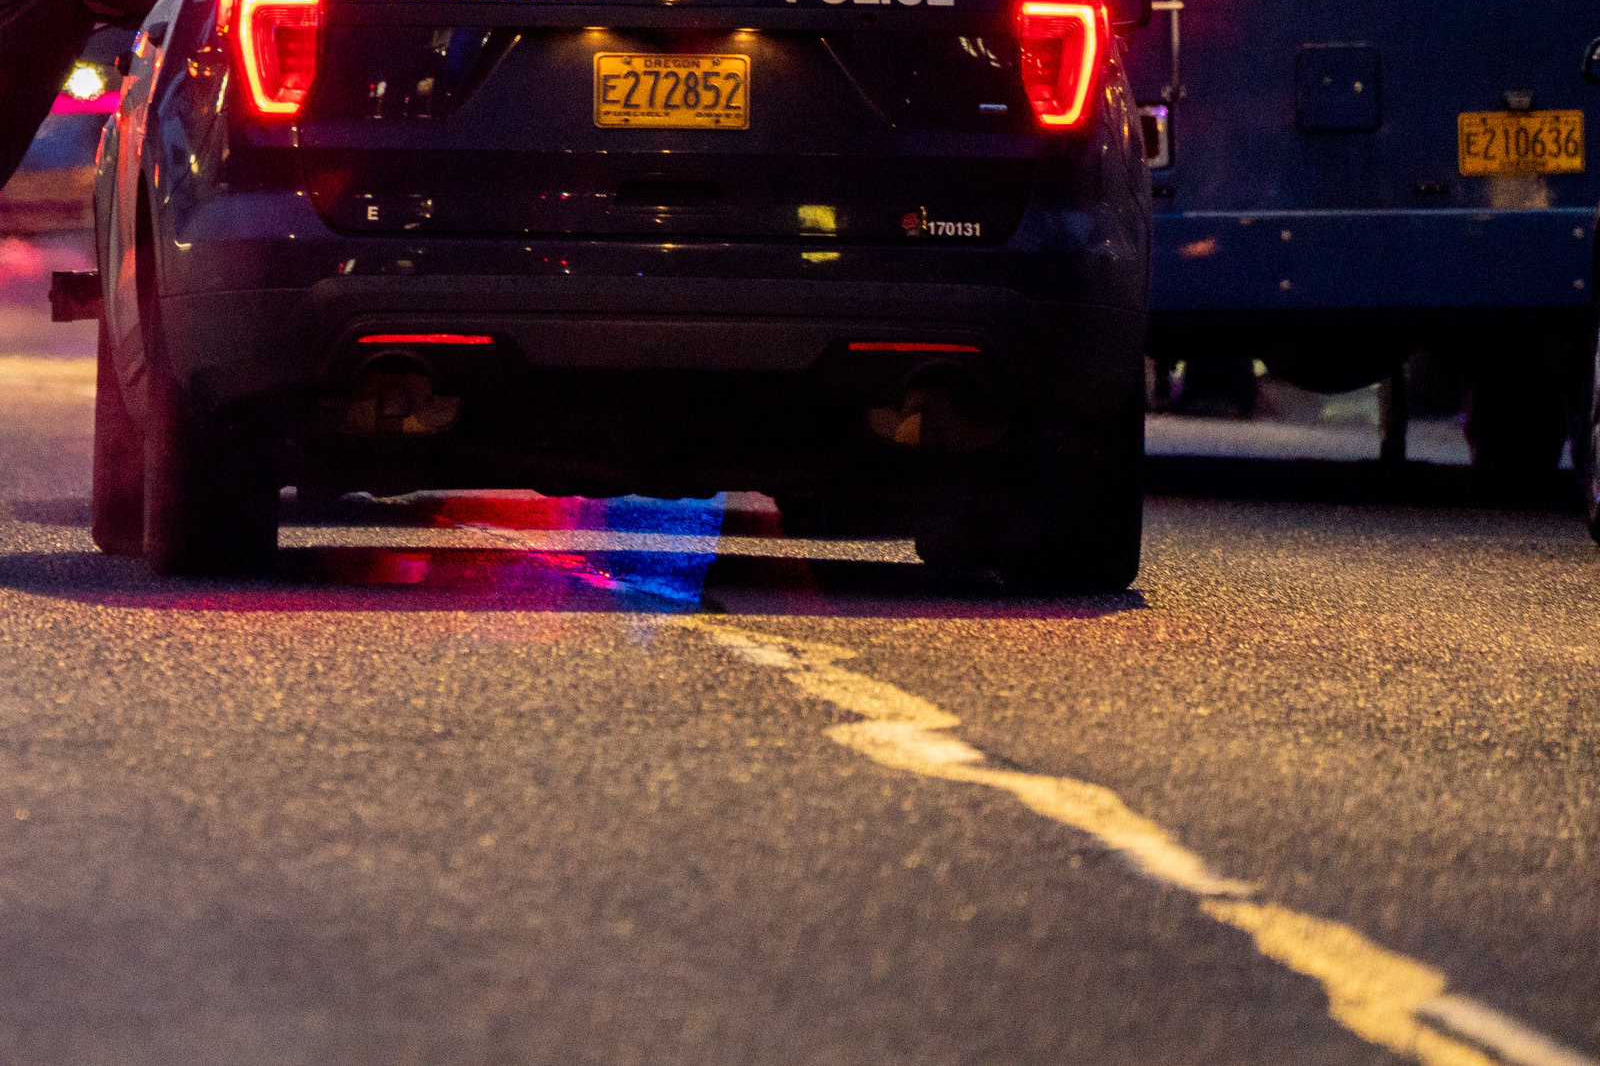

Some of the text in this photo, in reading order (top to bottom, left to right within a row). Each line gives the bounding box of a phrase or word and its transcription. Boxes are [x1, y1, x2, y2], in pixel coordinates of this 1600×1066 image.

[644, 58, 701, 69] OREGON
[601, 70, 742, 110] E272852
[1466, 126, 1579, 160] E210636
[367, 206, 379, 221] E
[928, 221, 981, 237] 170131
